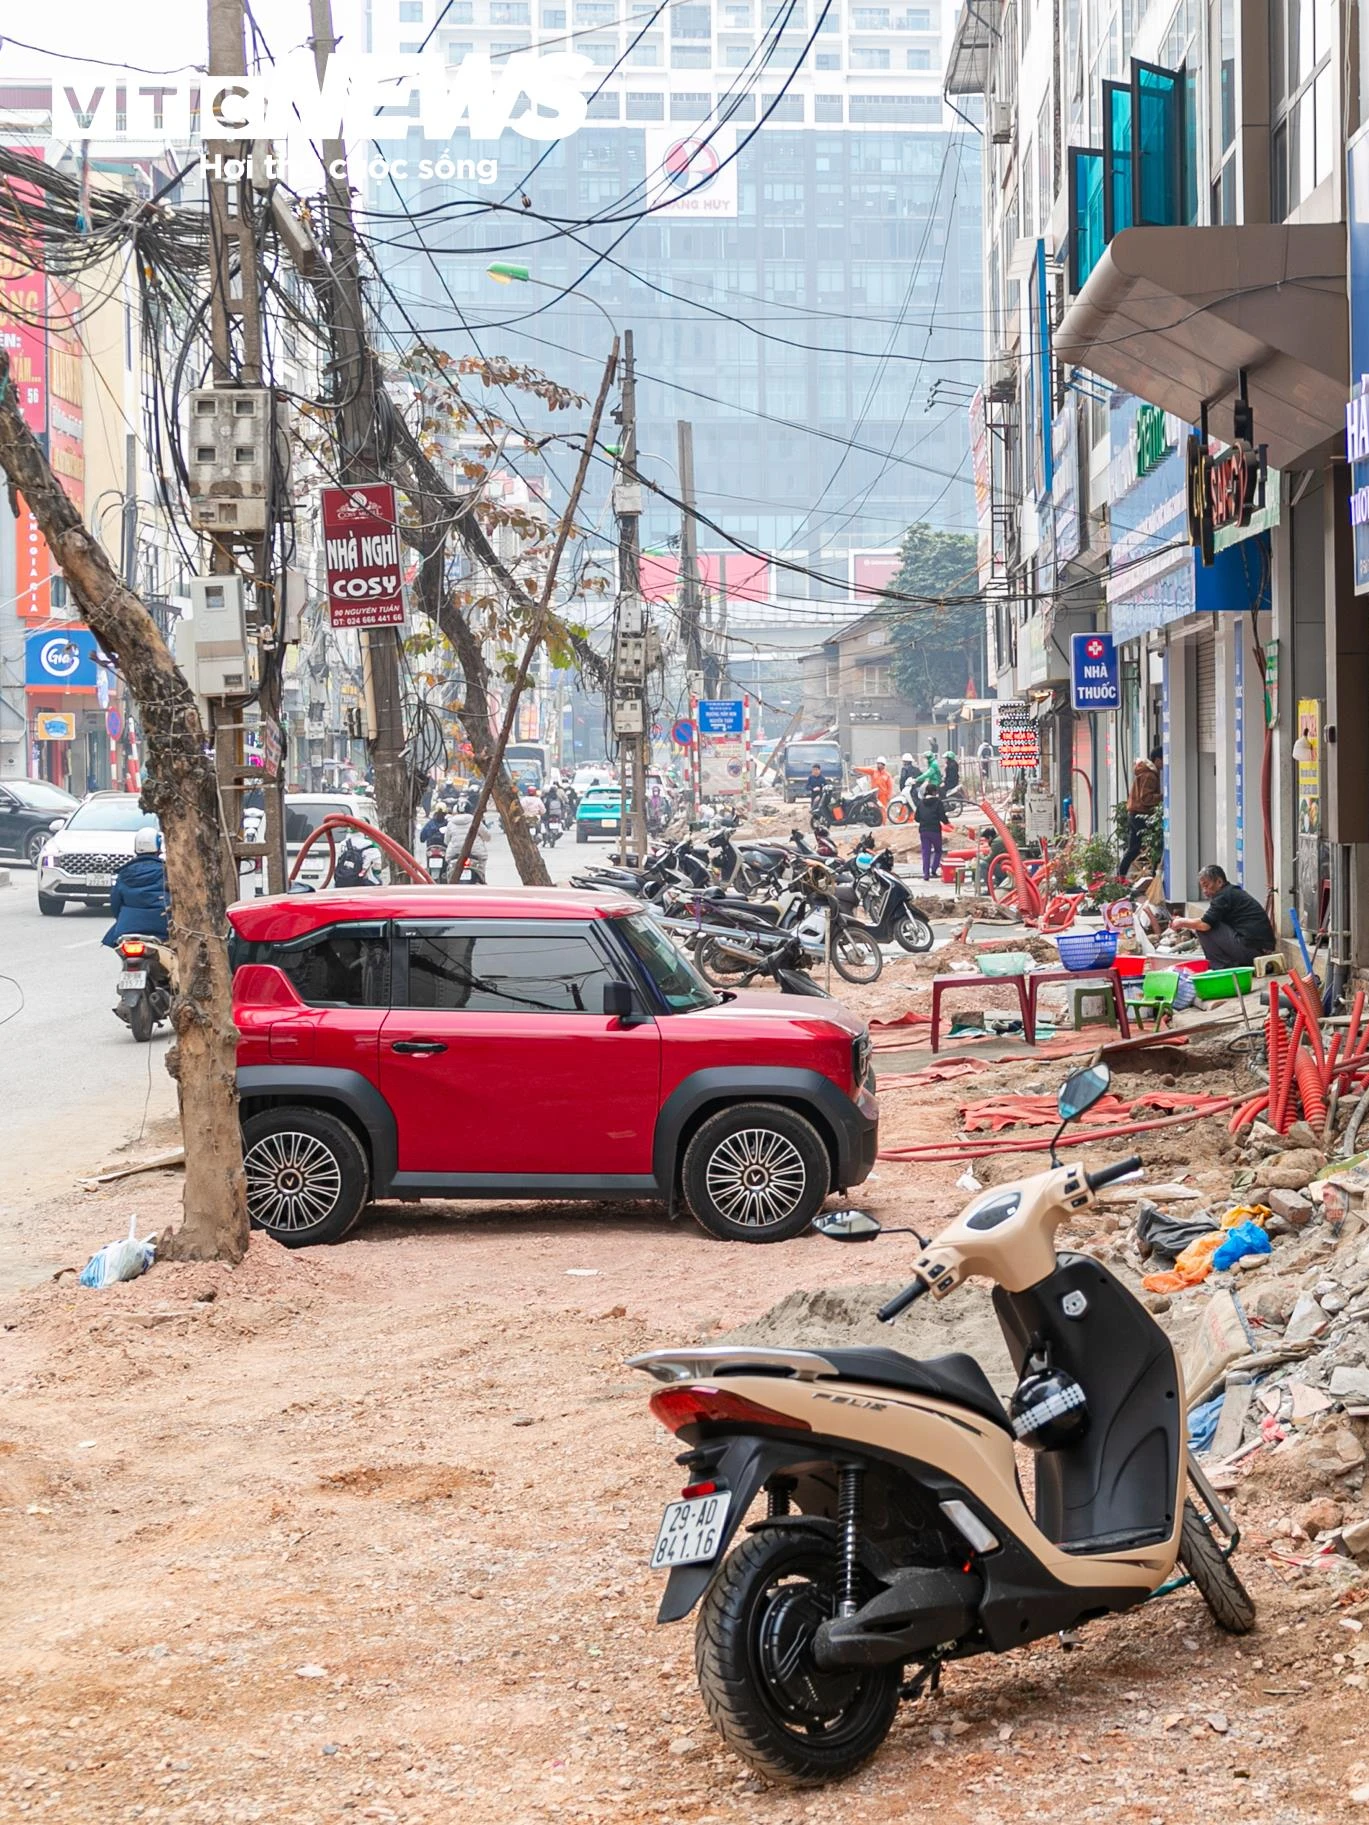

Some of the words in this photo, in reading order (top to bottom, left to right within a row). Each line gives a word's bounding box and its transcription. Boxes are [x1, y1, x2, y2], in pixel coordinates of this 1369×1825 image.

[703, 199, 730, 210] HUY
[327, 530, 358, 572] NHÀ
[361, 525, 398, 569] NGHỈ
[333, 576, 397, 597] COSY
[334, 609, 344, 617] 90
[1083, 662, 1109, 679] NHÀ
[1077, 681, 1117, 700] THUỐC
[656, 1528, 716, 1563] 841.16
